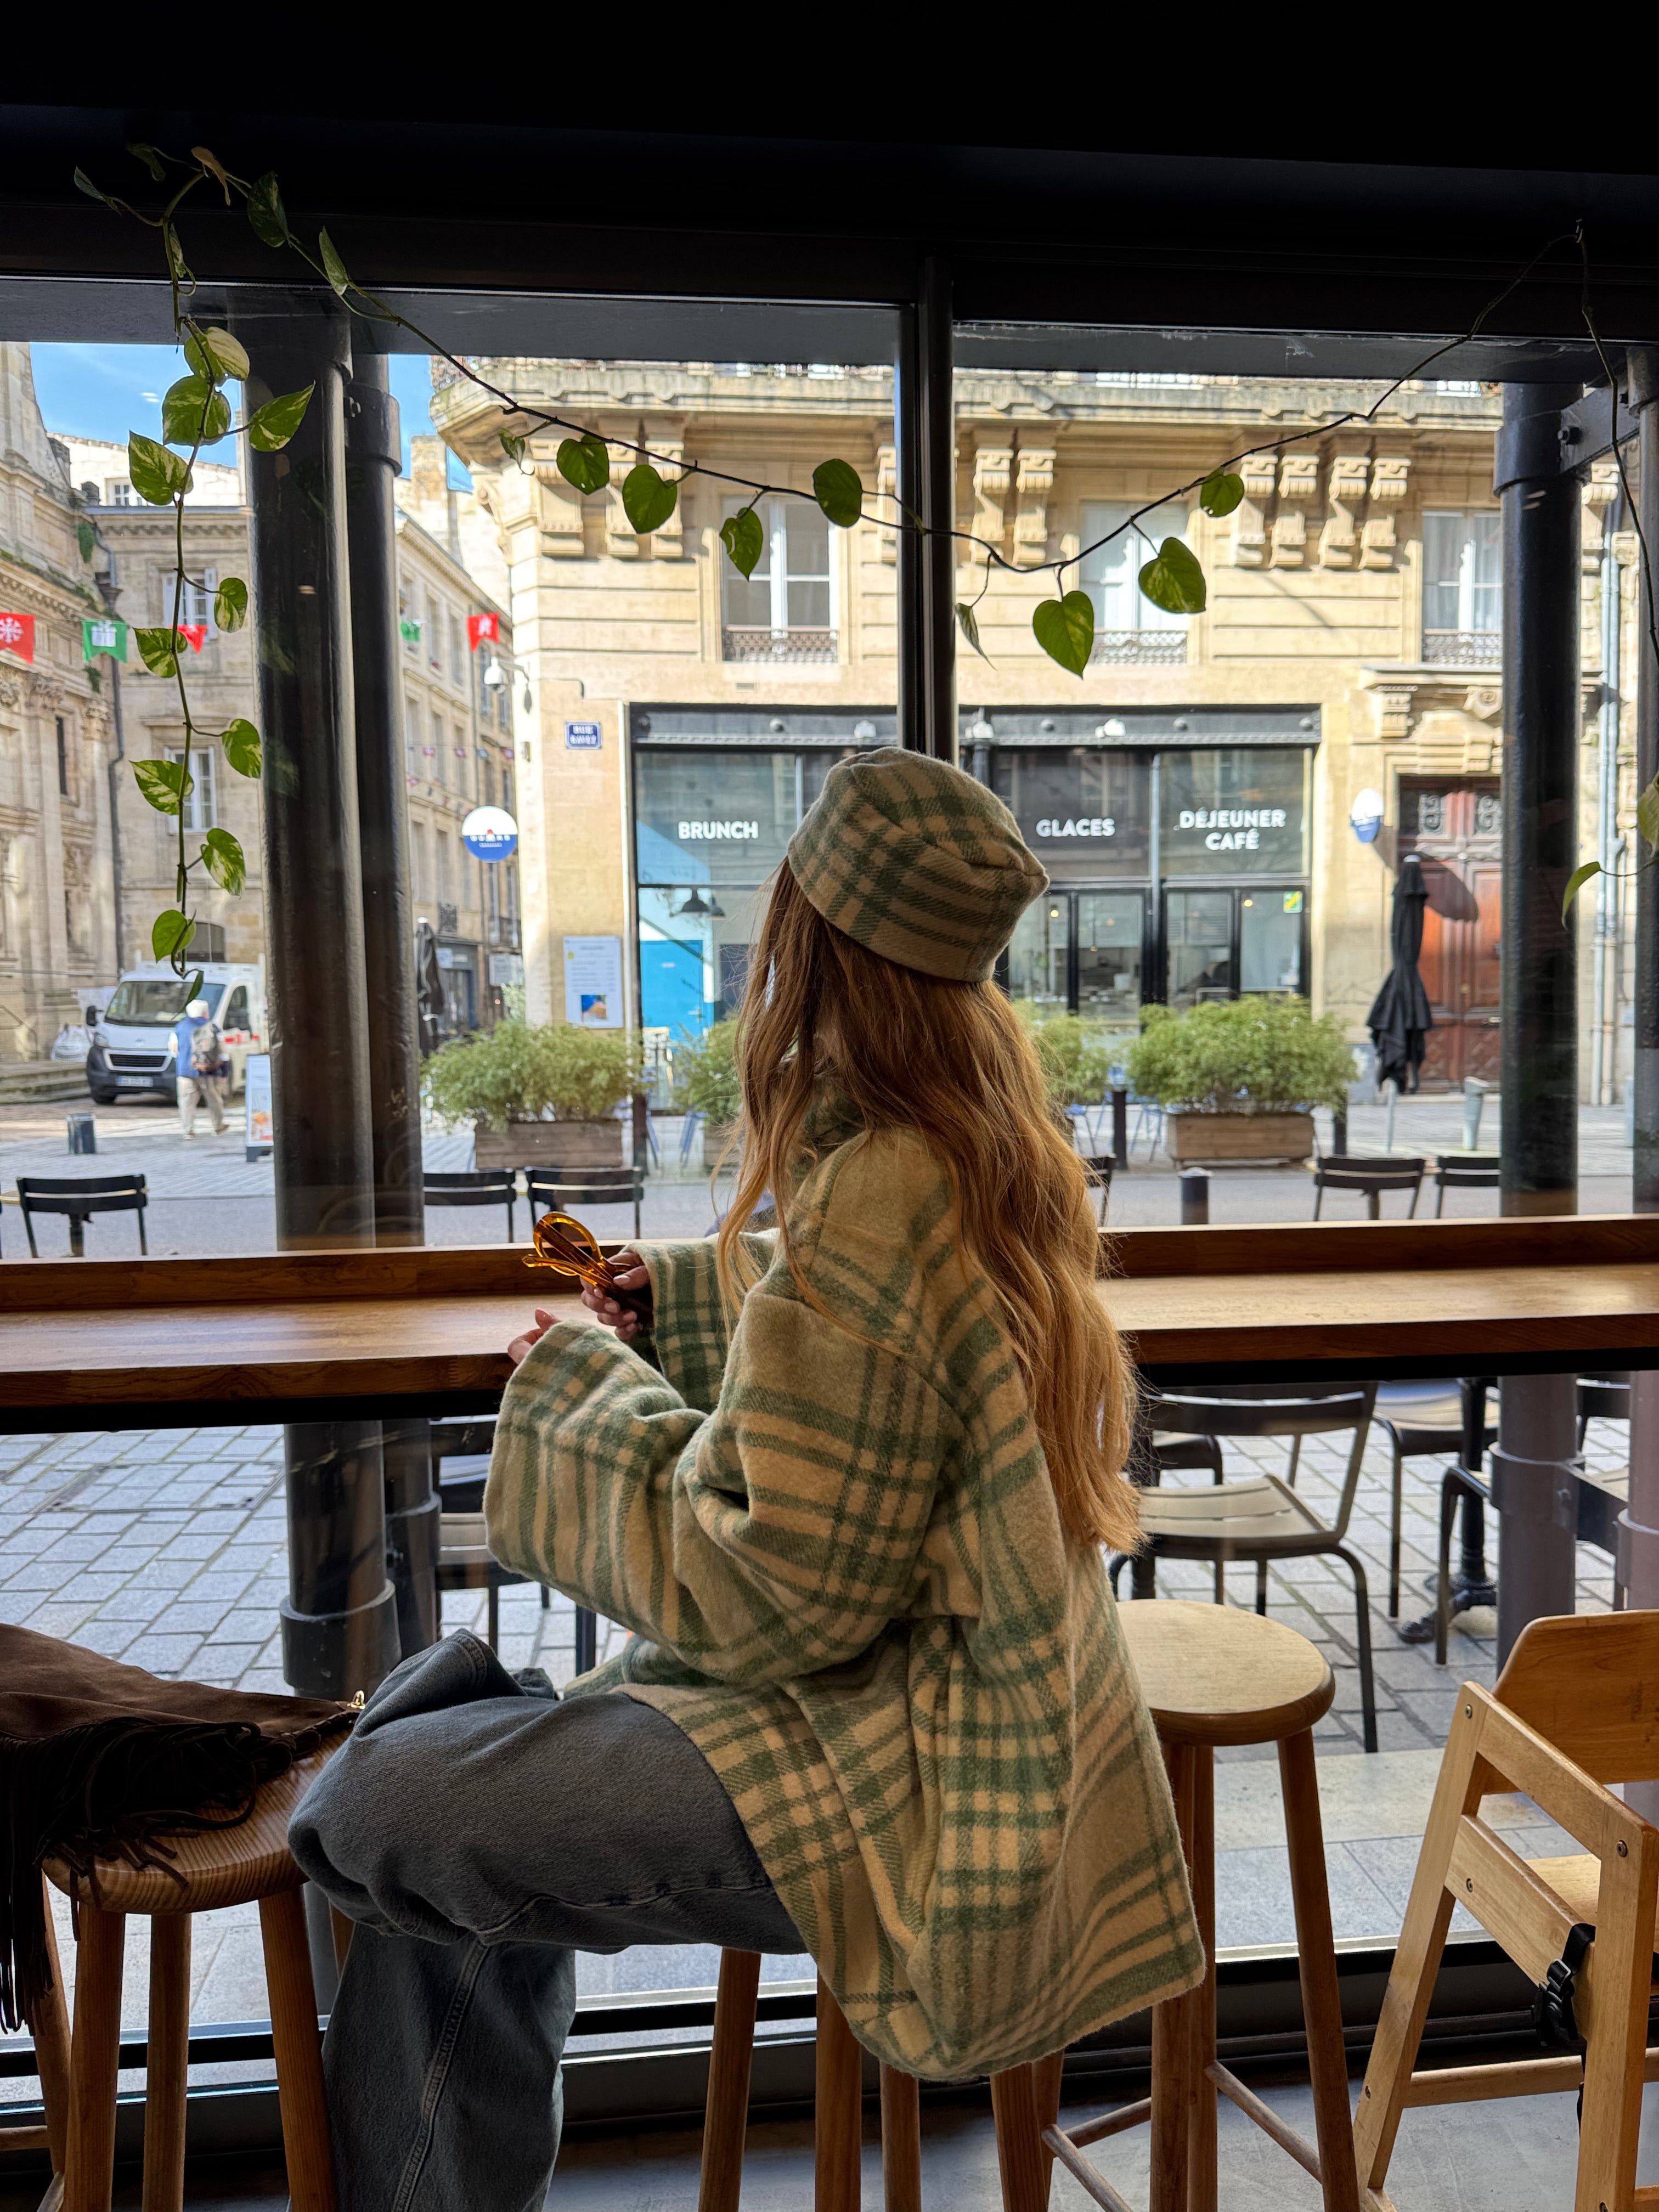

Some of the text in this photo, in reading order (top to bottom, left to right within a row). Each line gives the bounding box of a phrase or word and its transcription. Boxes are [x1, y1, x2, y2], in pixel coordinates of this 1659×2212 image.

[1180, 806, 1286, 828] DÉJEUNER
[678, 821, 759, 839] BRUNCH
[1036, 818, 1115, 837] GLACES
[1205, 828, 1260, 850] CAFÉ
